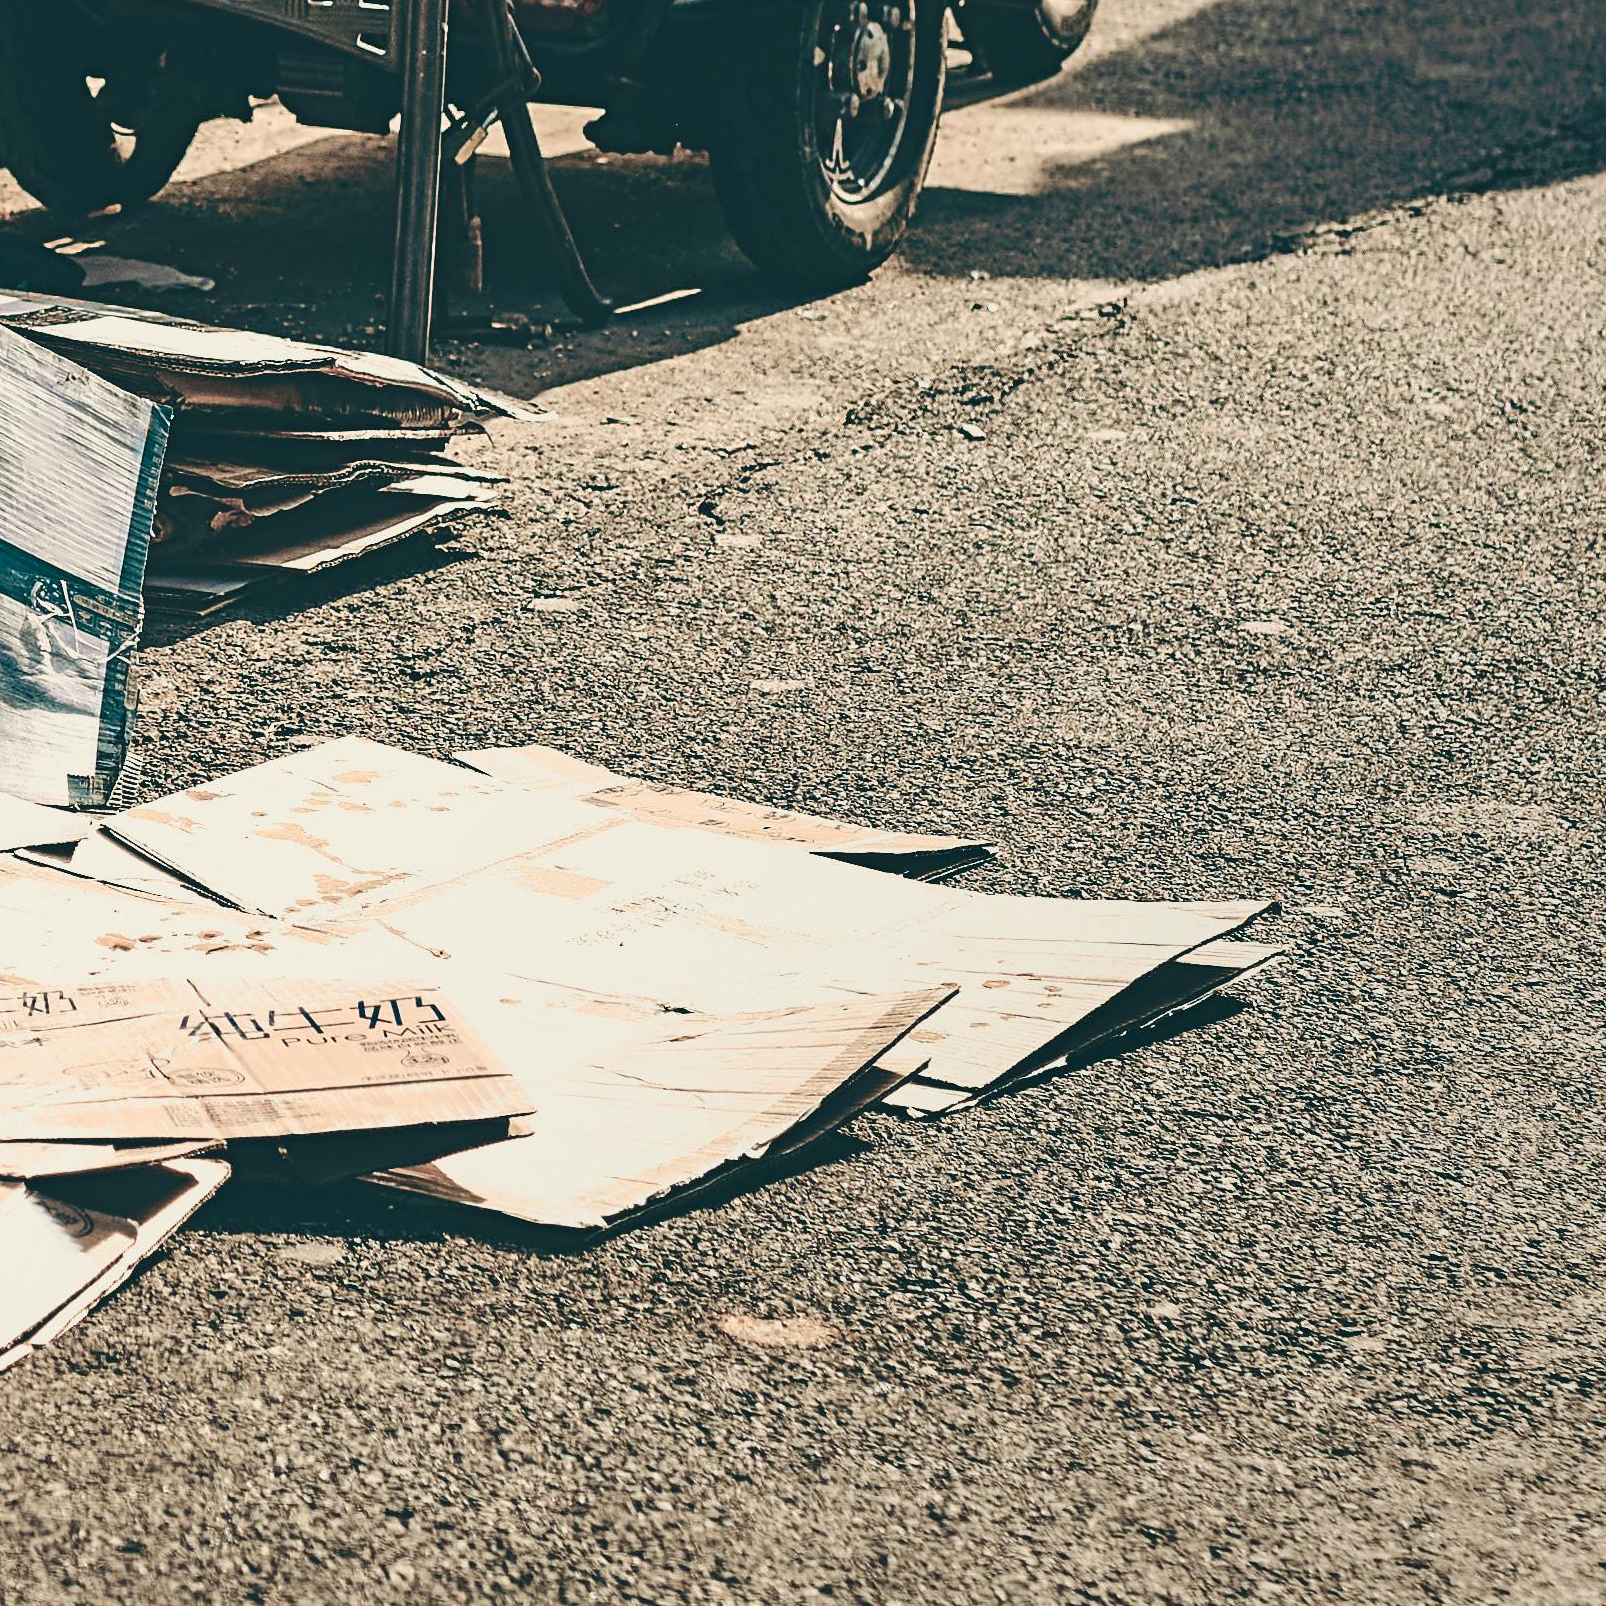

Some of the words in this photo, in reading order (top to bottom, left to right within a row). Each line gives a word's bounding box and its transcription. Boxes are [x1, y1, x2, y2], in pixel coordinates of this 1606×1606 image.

[180, 996, 448, 1042] 纯牛奶
[281, 1031, 367, 1048] Pure
[382, 1022, 454, 1039] Milk
